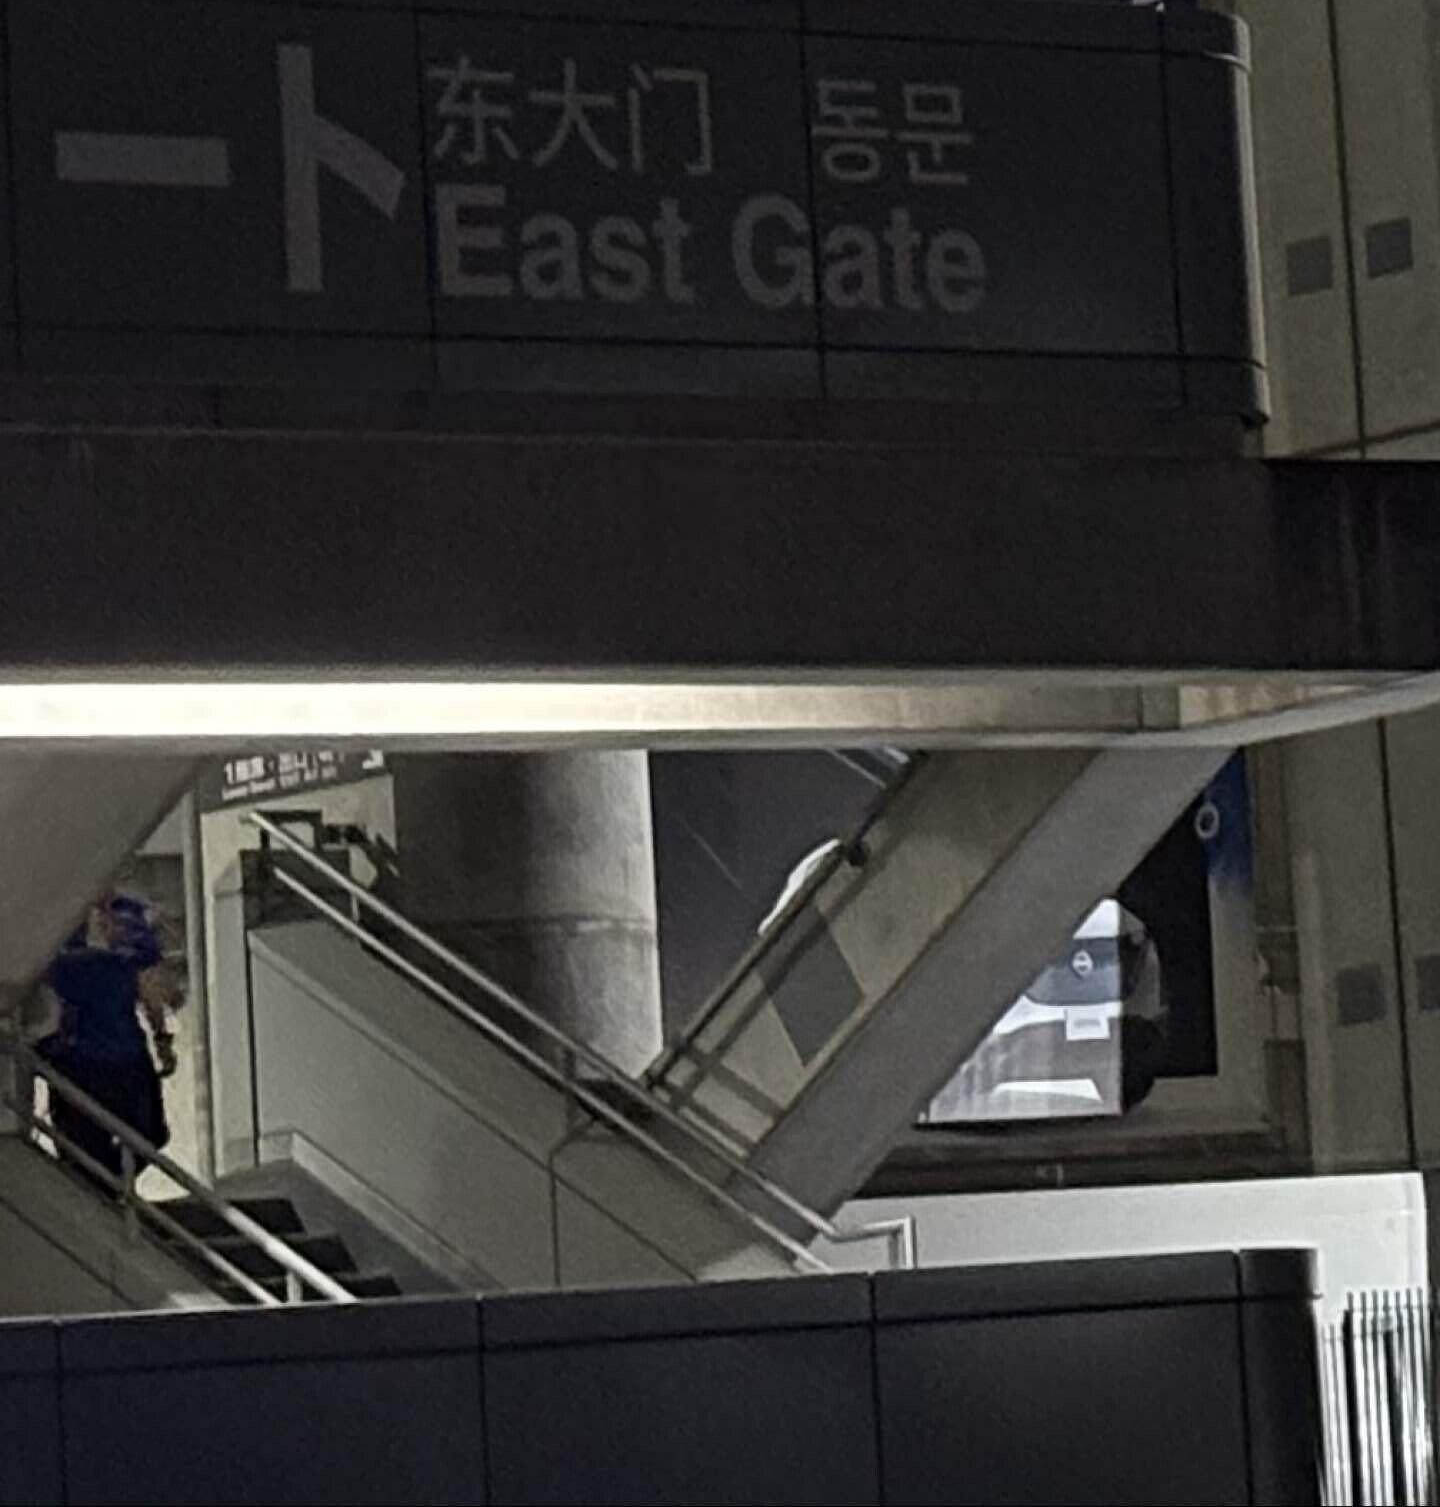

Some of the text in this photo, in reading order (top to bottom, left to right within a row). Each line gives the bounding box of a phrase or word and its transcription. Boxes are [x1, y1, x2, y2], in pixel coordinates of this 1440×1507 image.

[427, 55, 712, 175] 东大门
[809, 78, 974, 185] 동문
[434, 183, 989, 313] East Gate
